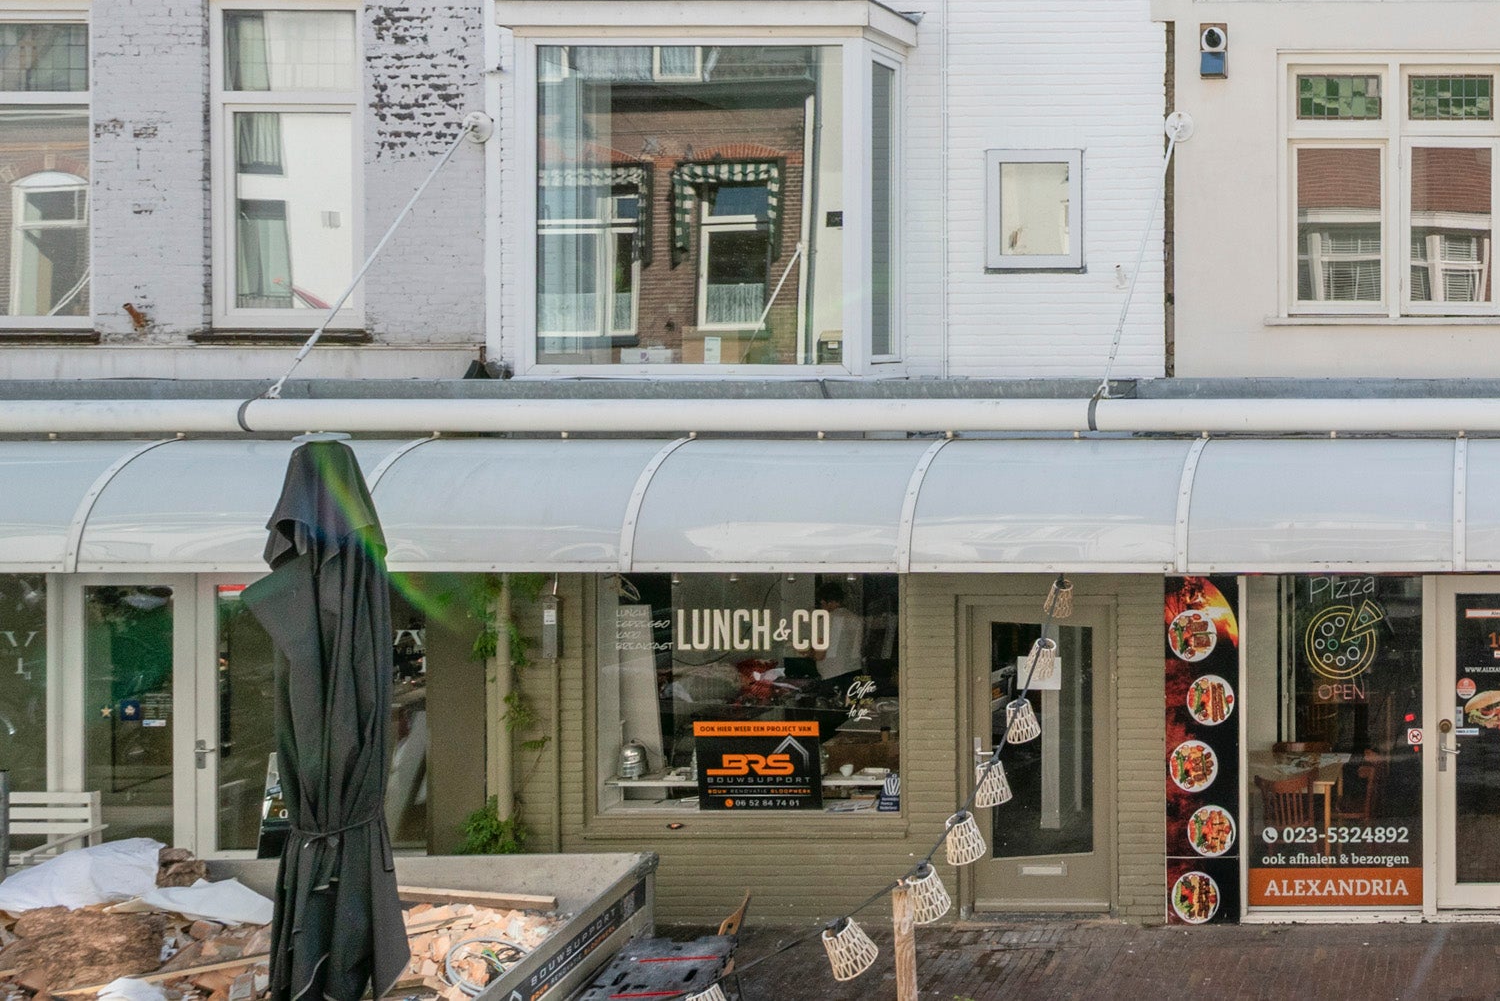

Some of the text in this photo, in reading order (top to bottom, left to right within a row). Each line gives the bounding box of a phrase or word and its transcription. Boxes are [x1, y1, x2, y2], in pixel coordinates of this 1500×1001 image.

[847, 680, 877, 699] Coffee
[1318, 684, 1365, 700] OPEN
[707, 754, 795, 775] BRS
[1282, 827, 1409, 843] 023-5324892
[1262, 853, 1409, 867] ook afhalen & bezorgen
[1264, 879, 1409, 896] ALEXANDRIA
[530, 908, 616, 987] BOUWSUPPORT
